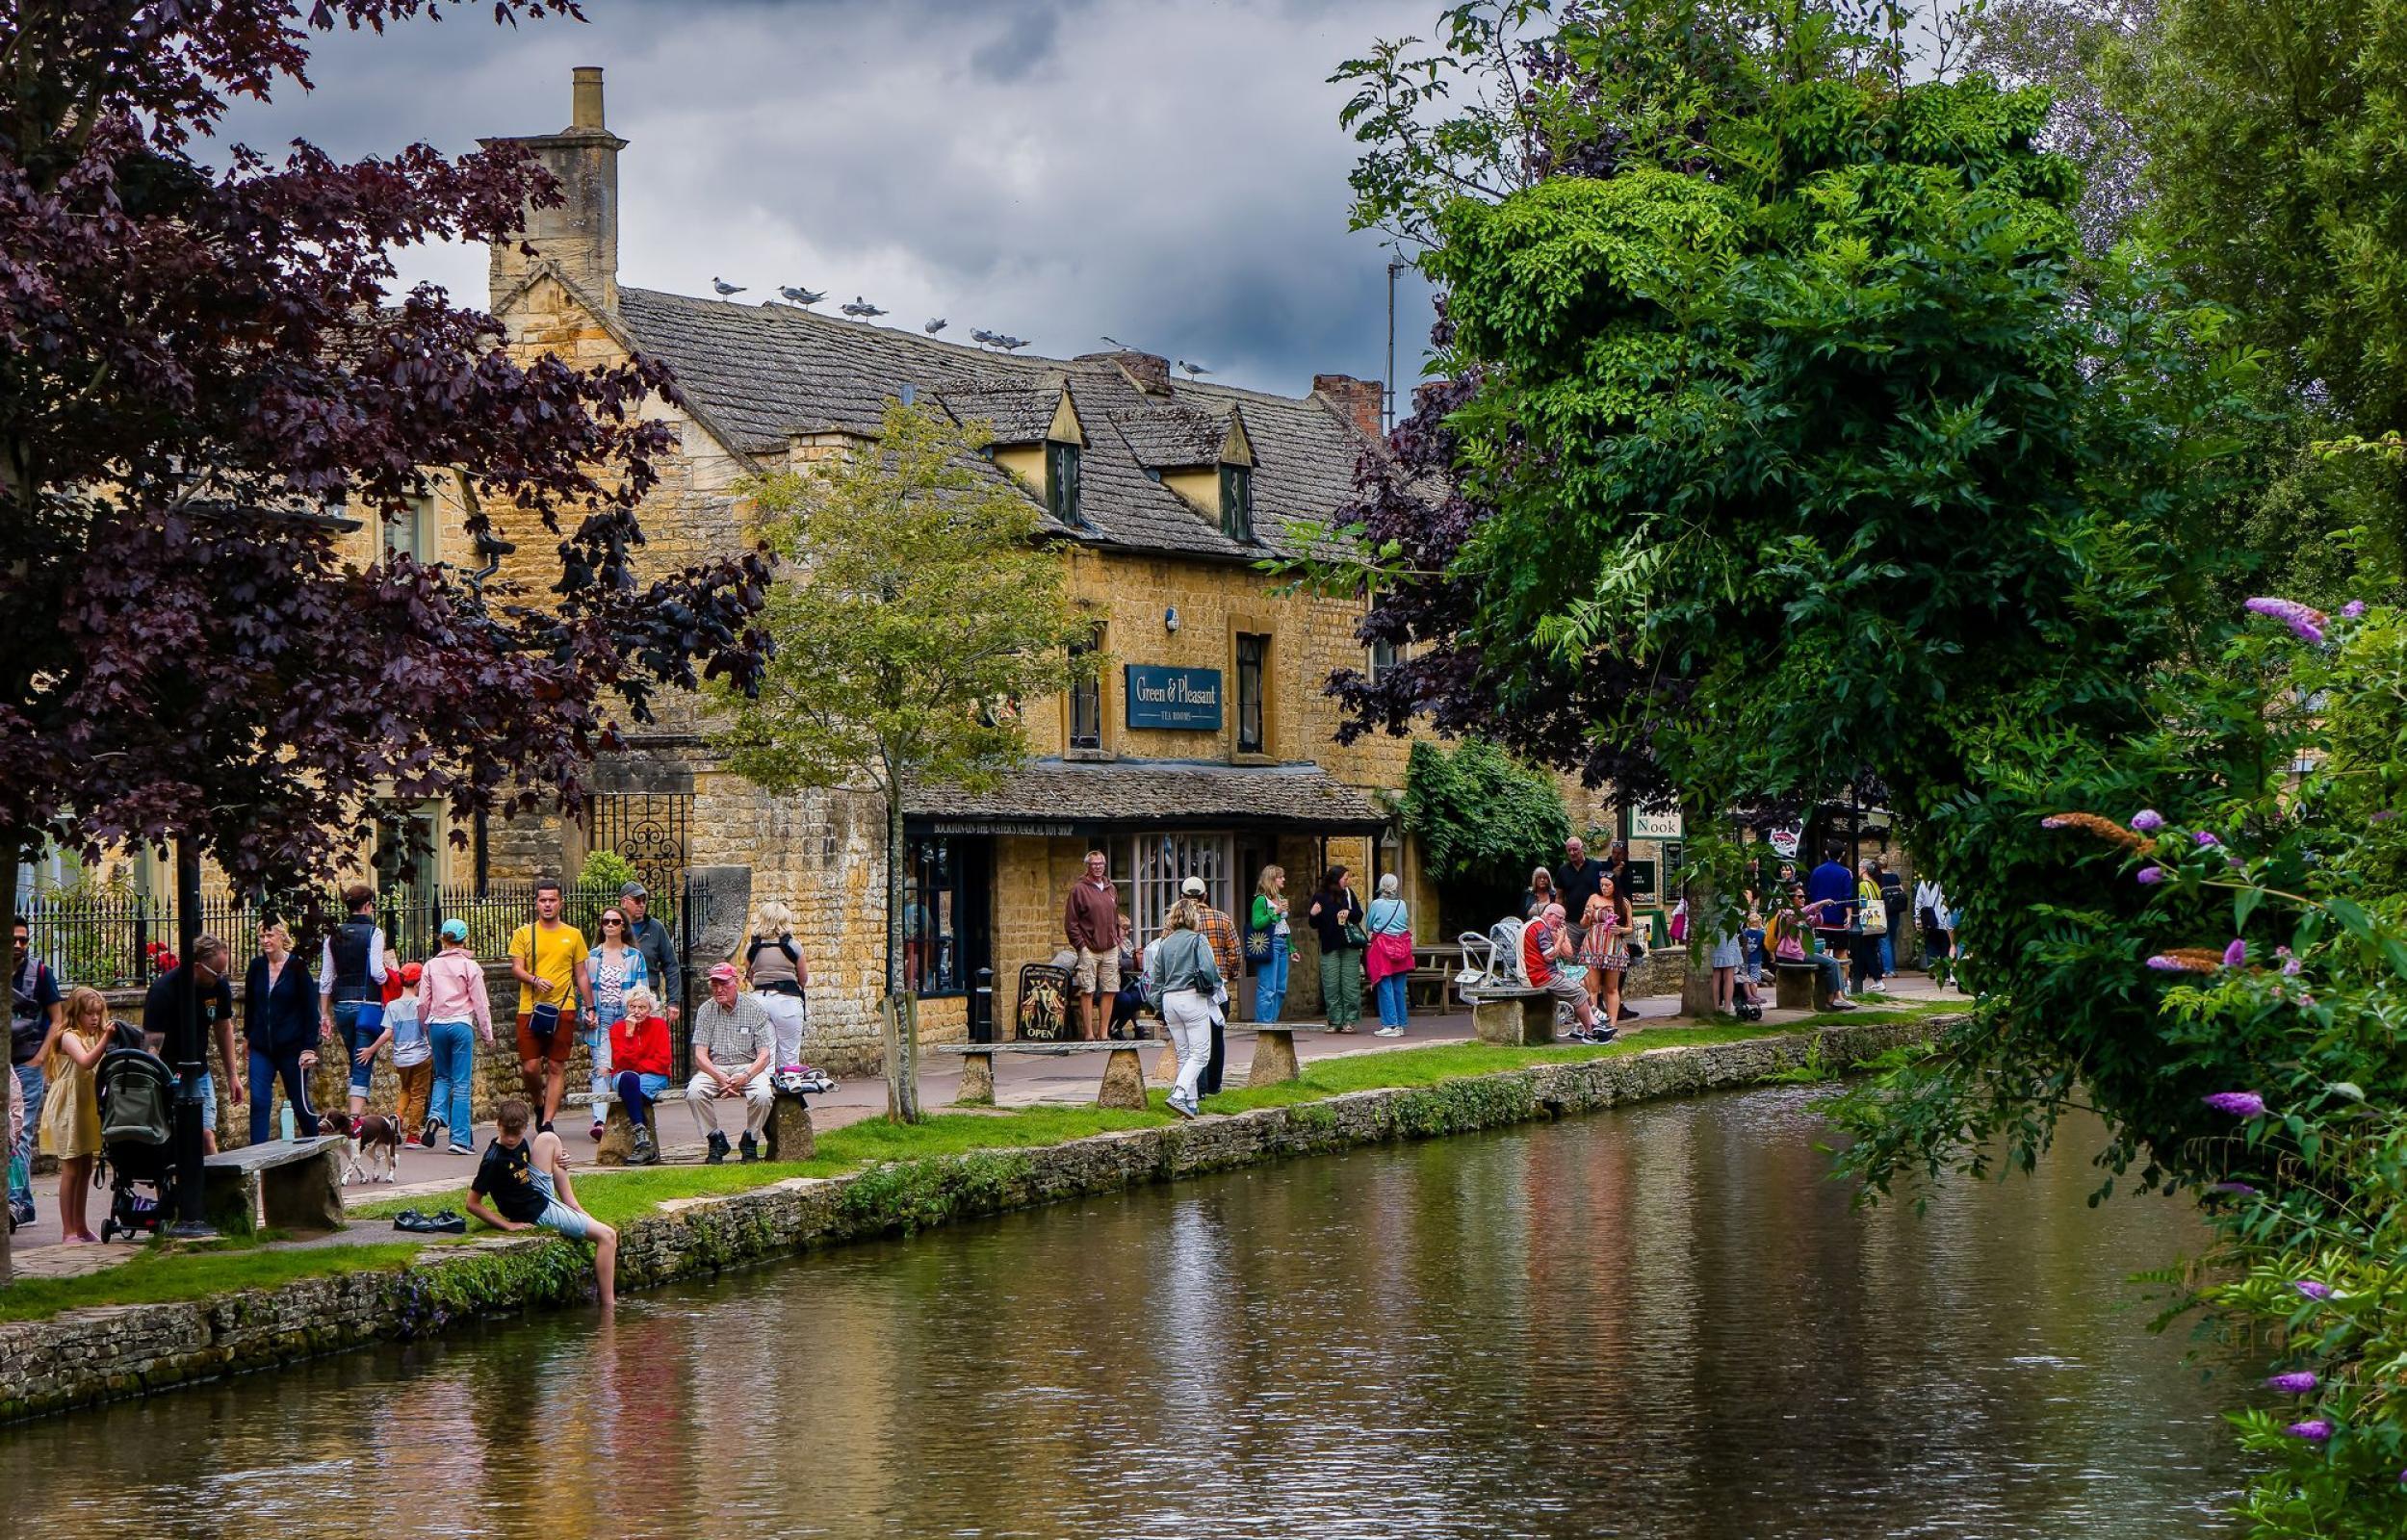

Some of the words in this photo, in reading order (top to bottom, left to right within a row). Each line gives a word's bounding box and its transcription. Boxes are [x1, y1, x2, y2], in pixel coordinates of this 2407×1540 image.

[1136, 676, 1166, 703] Green
[1167, 677, 1177, 703] &
[1178, 674, 1216, 705] Pleasant
[1160, 710, 1172, 721] TEA
[1173, 711, 1191, 721] ROOMS
[1637, 819, 1676, 834] Nook
[1026, 1028, 1055, 1040] OPEN
